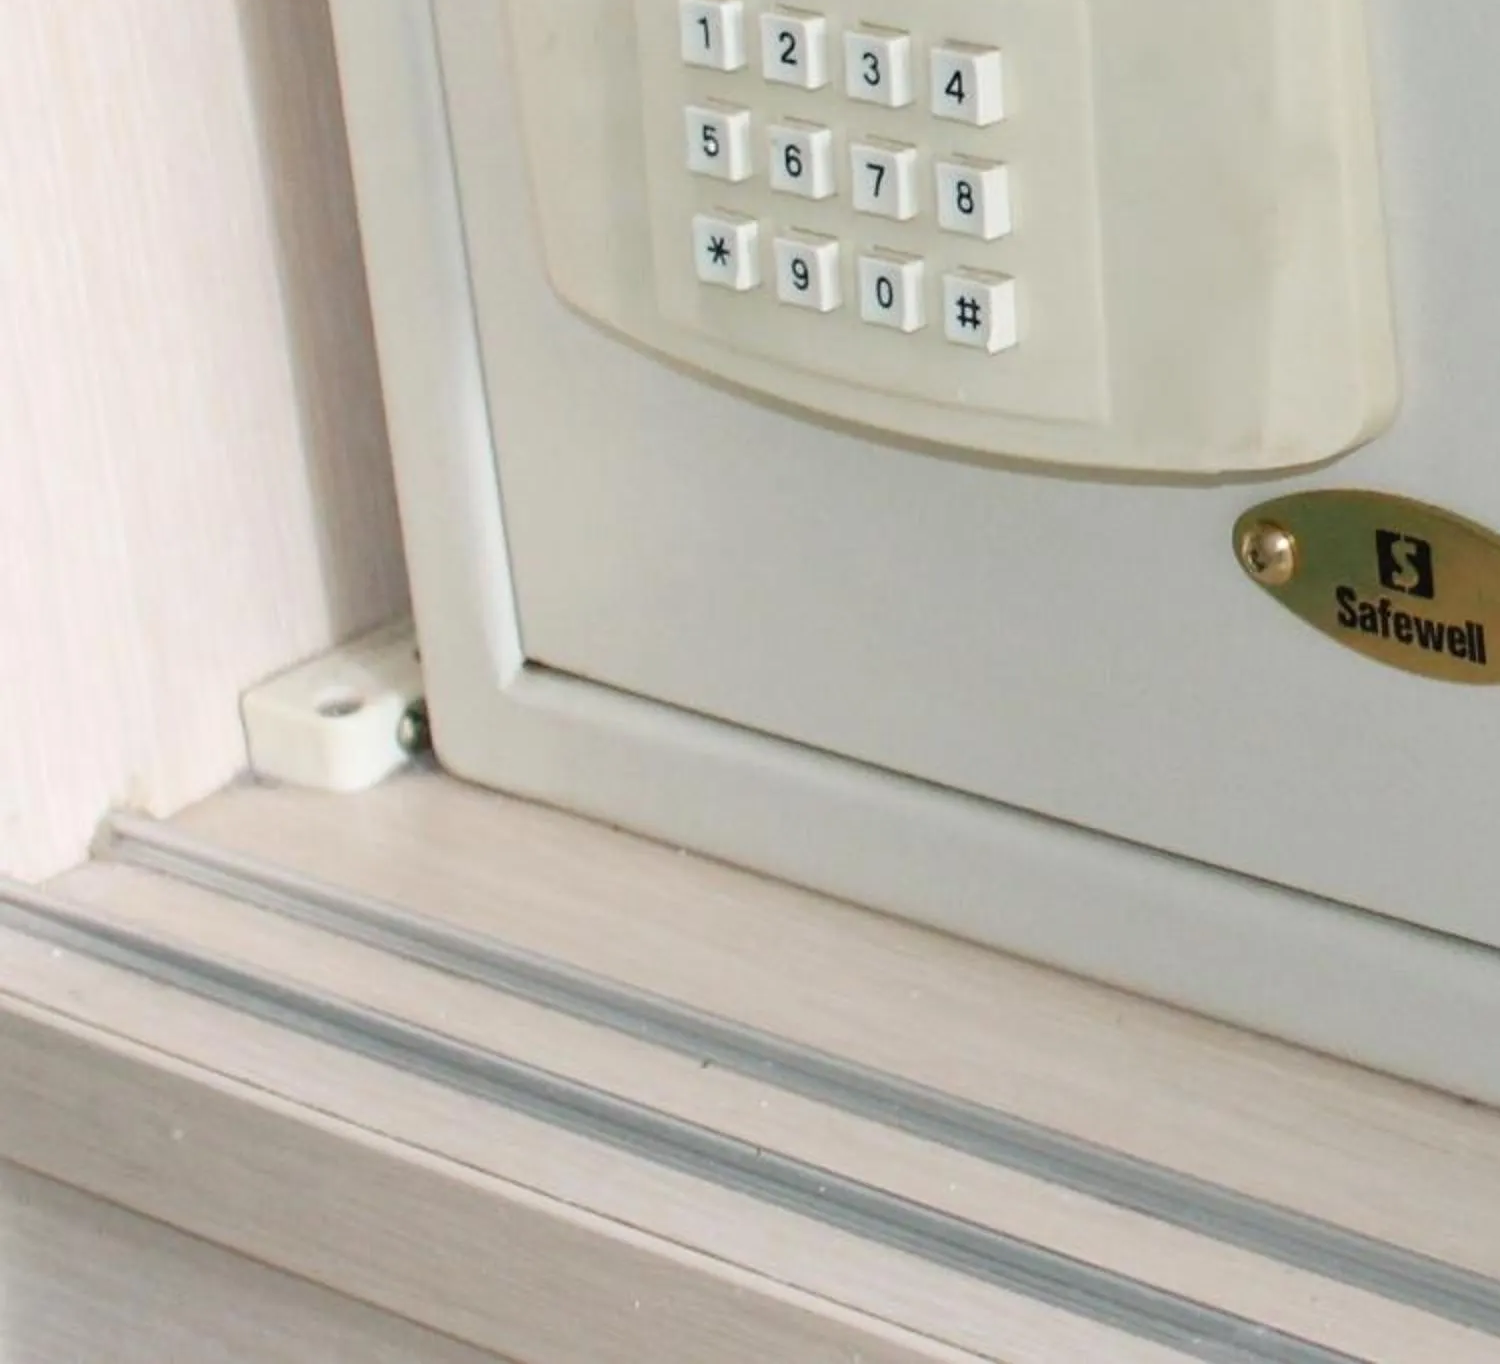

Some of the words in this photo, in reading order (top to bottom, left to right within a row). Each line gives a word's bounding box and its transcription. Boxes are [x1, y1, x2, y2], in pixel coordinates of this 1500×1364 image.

[696, 16, 711, 49] 1
[778, 31, 798, 65] 2
[862, 52, 881, 86] 3
[944, 69, 965, 104] 4
[702, 124, 720, 158] 5
[784, 144, 802, 178] 6
[865, 163, 885, 197] 7
[956, 180, 974, 215] 8
[791, 258, 809, 292] 9
[876, 276, 893, 309] 0
[1336, 585, 1487, 666] Safewell
